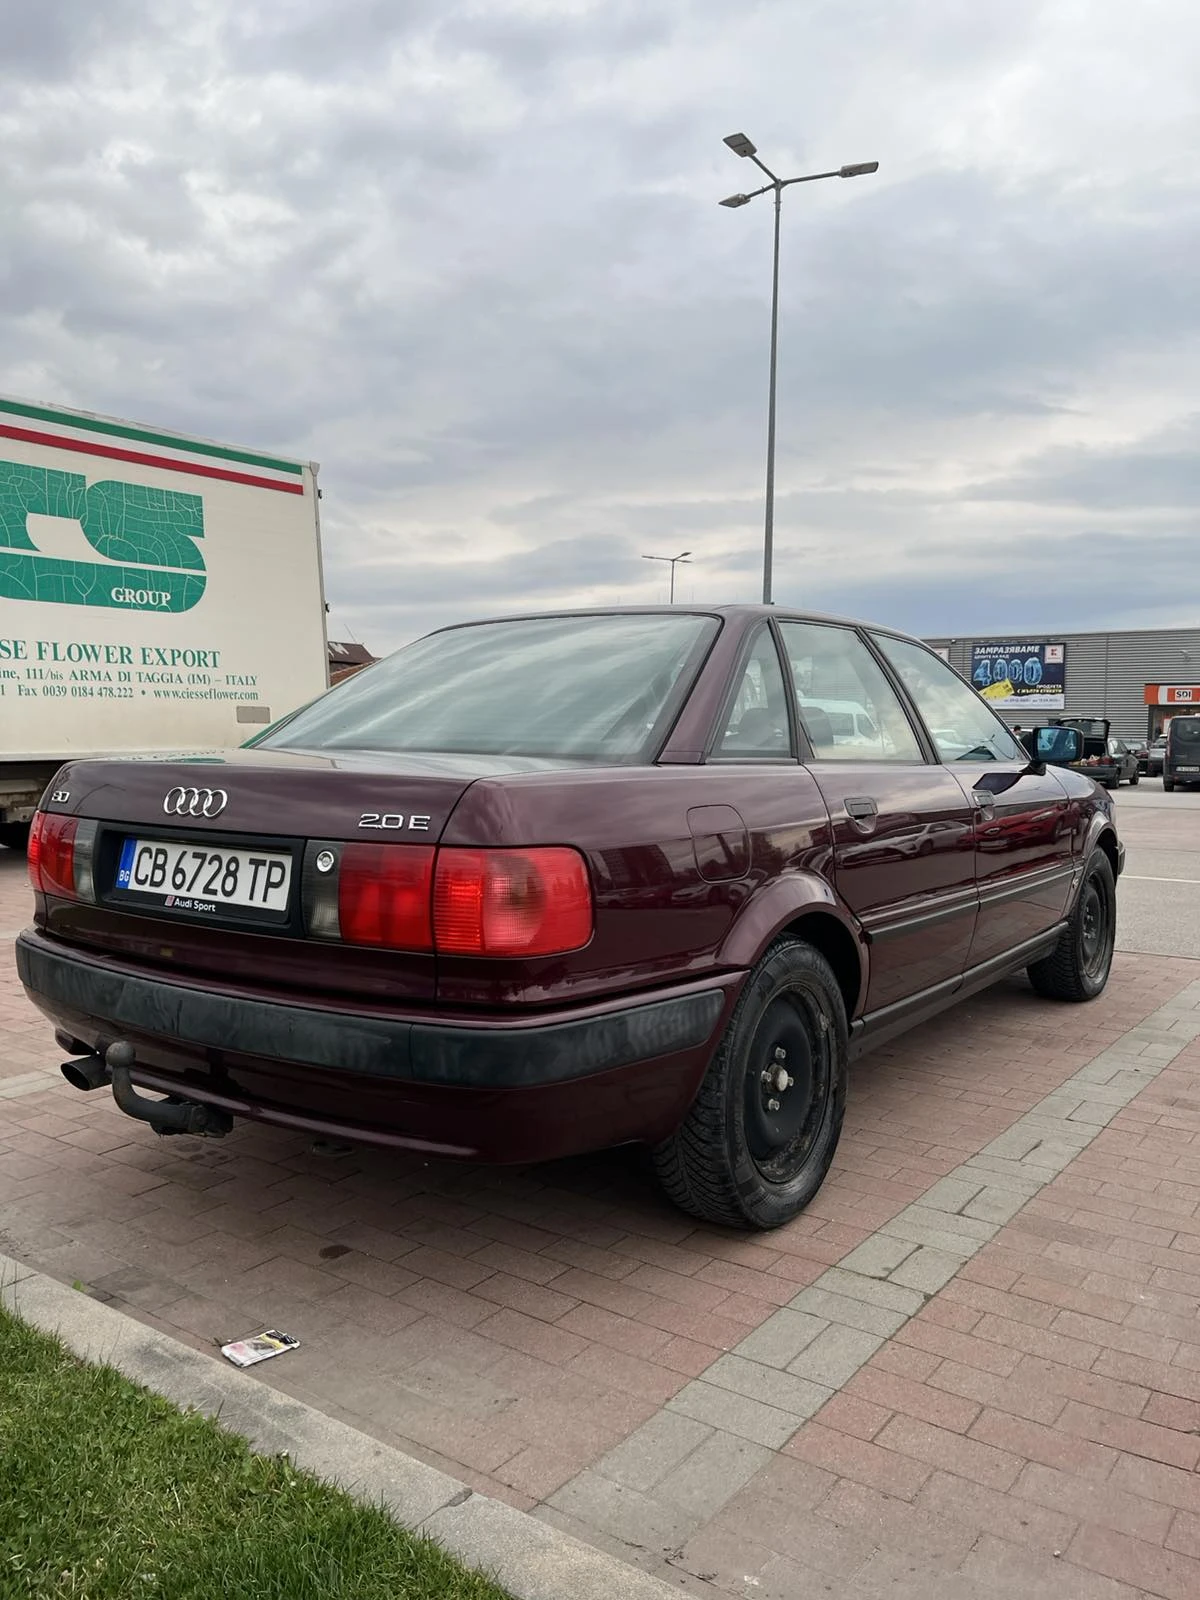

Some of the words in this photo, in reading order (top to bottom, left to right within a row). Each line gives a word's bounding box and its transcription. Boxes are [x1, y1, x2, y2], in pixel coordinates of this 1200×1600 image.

[111, 587, 171, 606] GROUP
[36, 640, 133, 664] FLOWER
[140, 646, 220, 668] EXPORT
[974, 645, 1040, 654] ЗАМРАЗЯВАМЕ
[0, 669, 20, 680] ne,
[69, 669, 113, 682] ARMA
[118, 671, 131, 683] DI
[136, 672, 183, 684] TAGGIA
[187, 673, 211, 685] (IM)
[225, 675, 258, 687] ITALY
[973, 657, 1042, 686] 4000
[18, 684, 37, 697] Fax
[42, 685, 67, 697] 0039
[71, 686, 94, 698] 0184
[97, 686, 134, 698] 478.222
[153, 687, 259, 701] www.ciesseflower.com
[408, 815, 431, 831] E
[119, 869, 130, 882] BG
[134, 846, 169, 888] CB
[171, 850, 240, 898] 6728
[248, 857, 286, 903] TP
[174, 898, 193, 908] Audi
[193, 900, 216, 913] Sport
